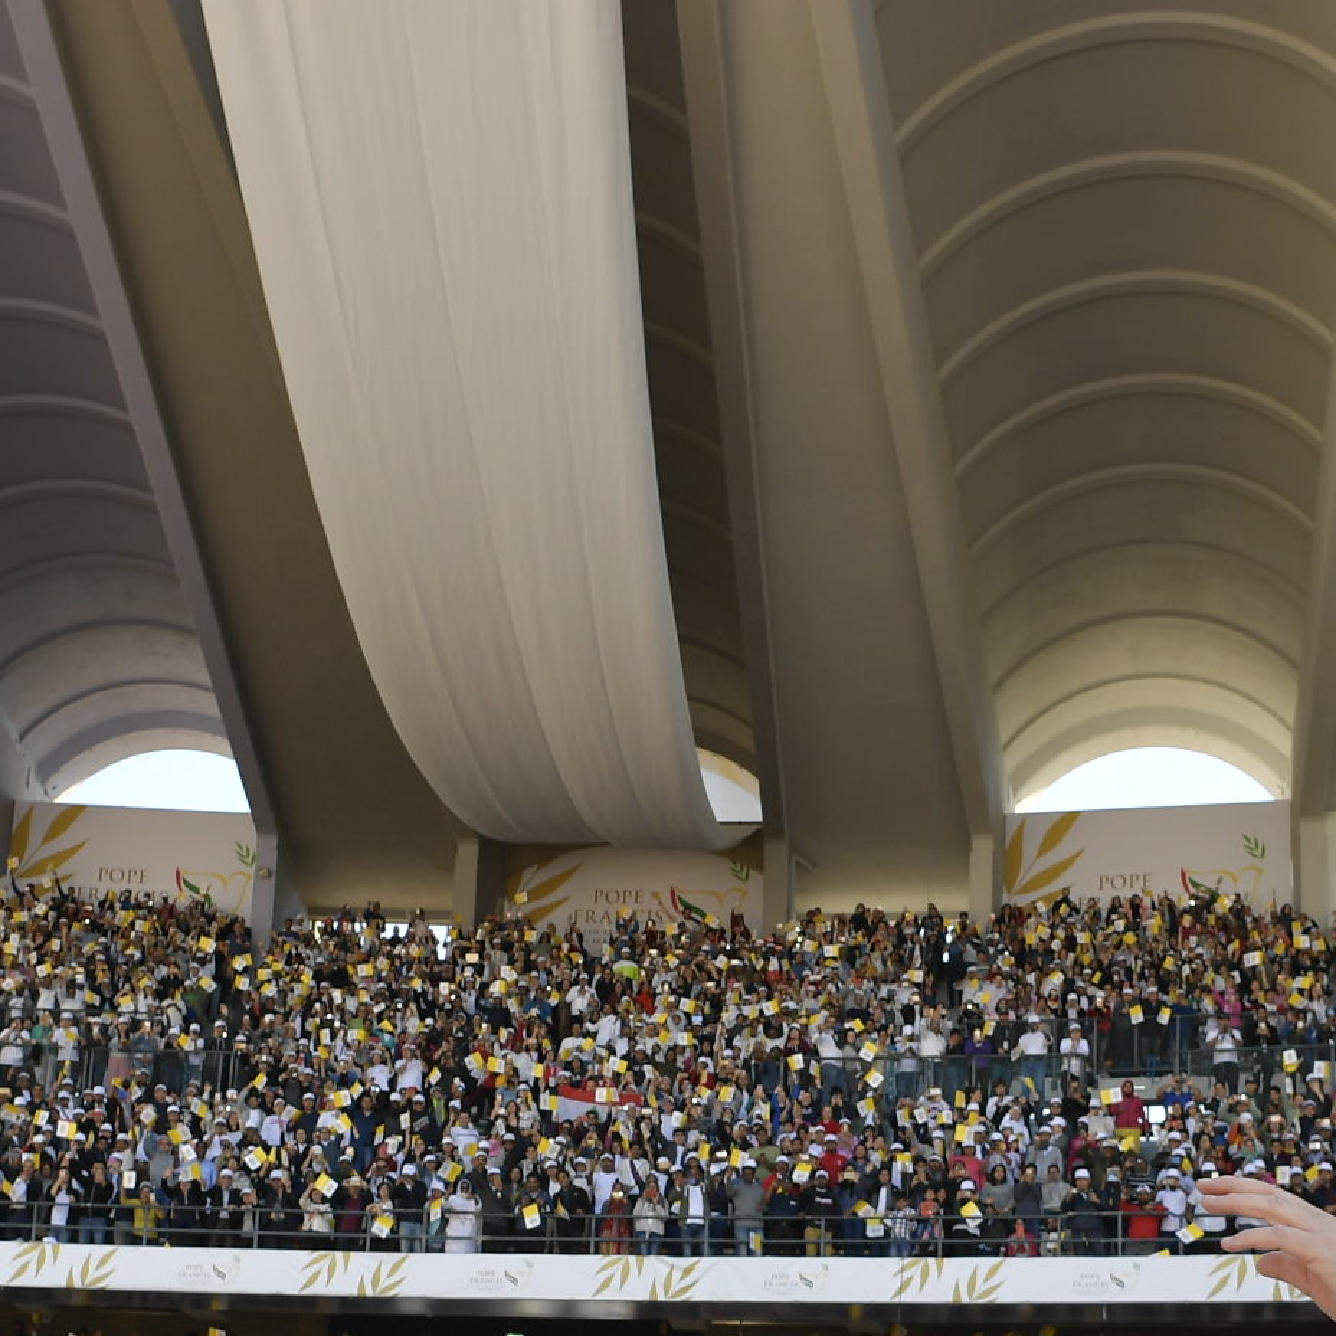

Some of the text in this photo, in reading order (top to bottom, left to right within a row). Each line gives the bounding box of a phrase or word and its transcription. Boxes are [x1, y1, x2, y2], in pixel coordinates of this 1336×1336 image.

[97, 867, 149, 885] POPE
[1098, 873, 1152, 891] POPE
[594, 888, 642, 904] POPE
